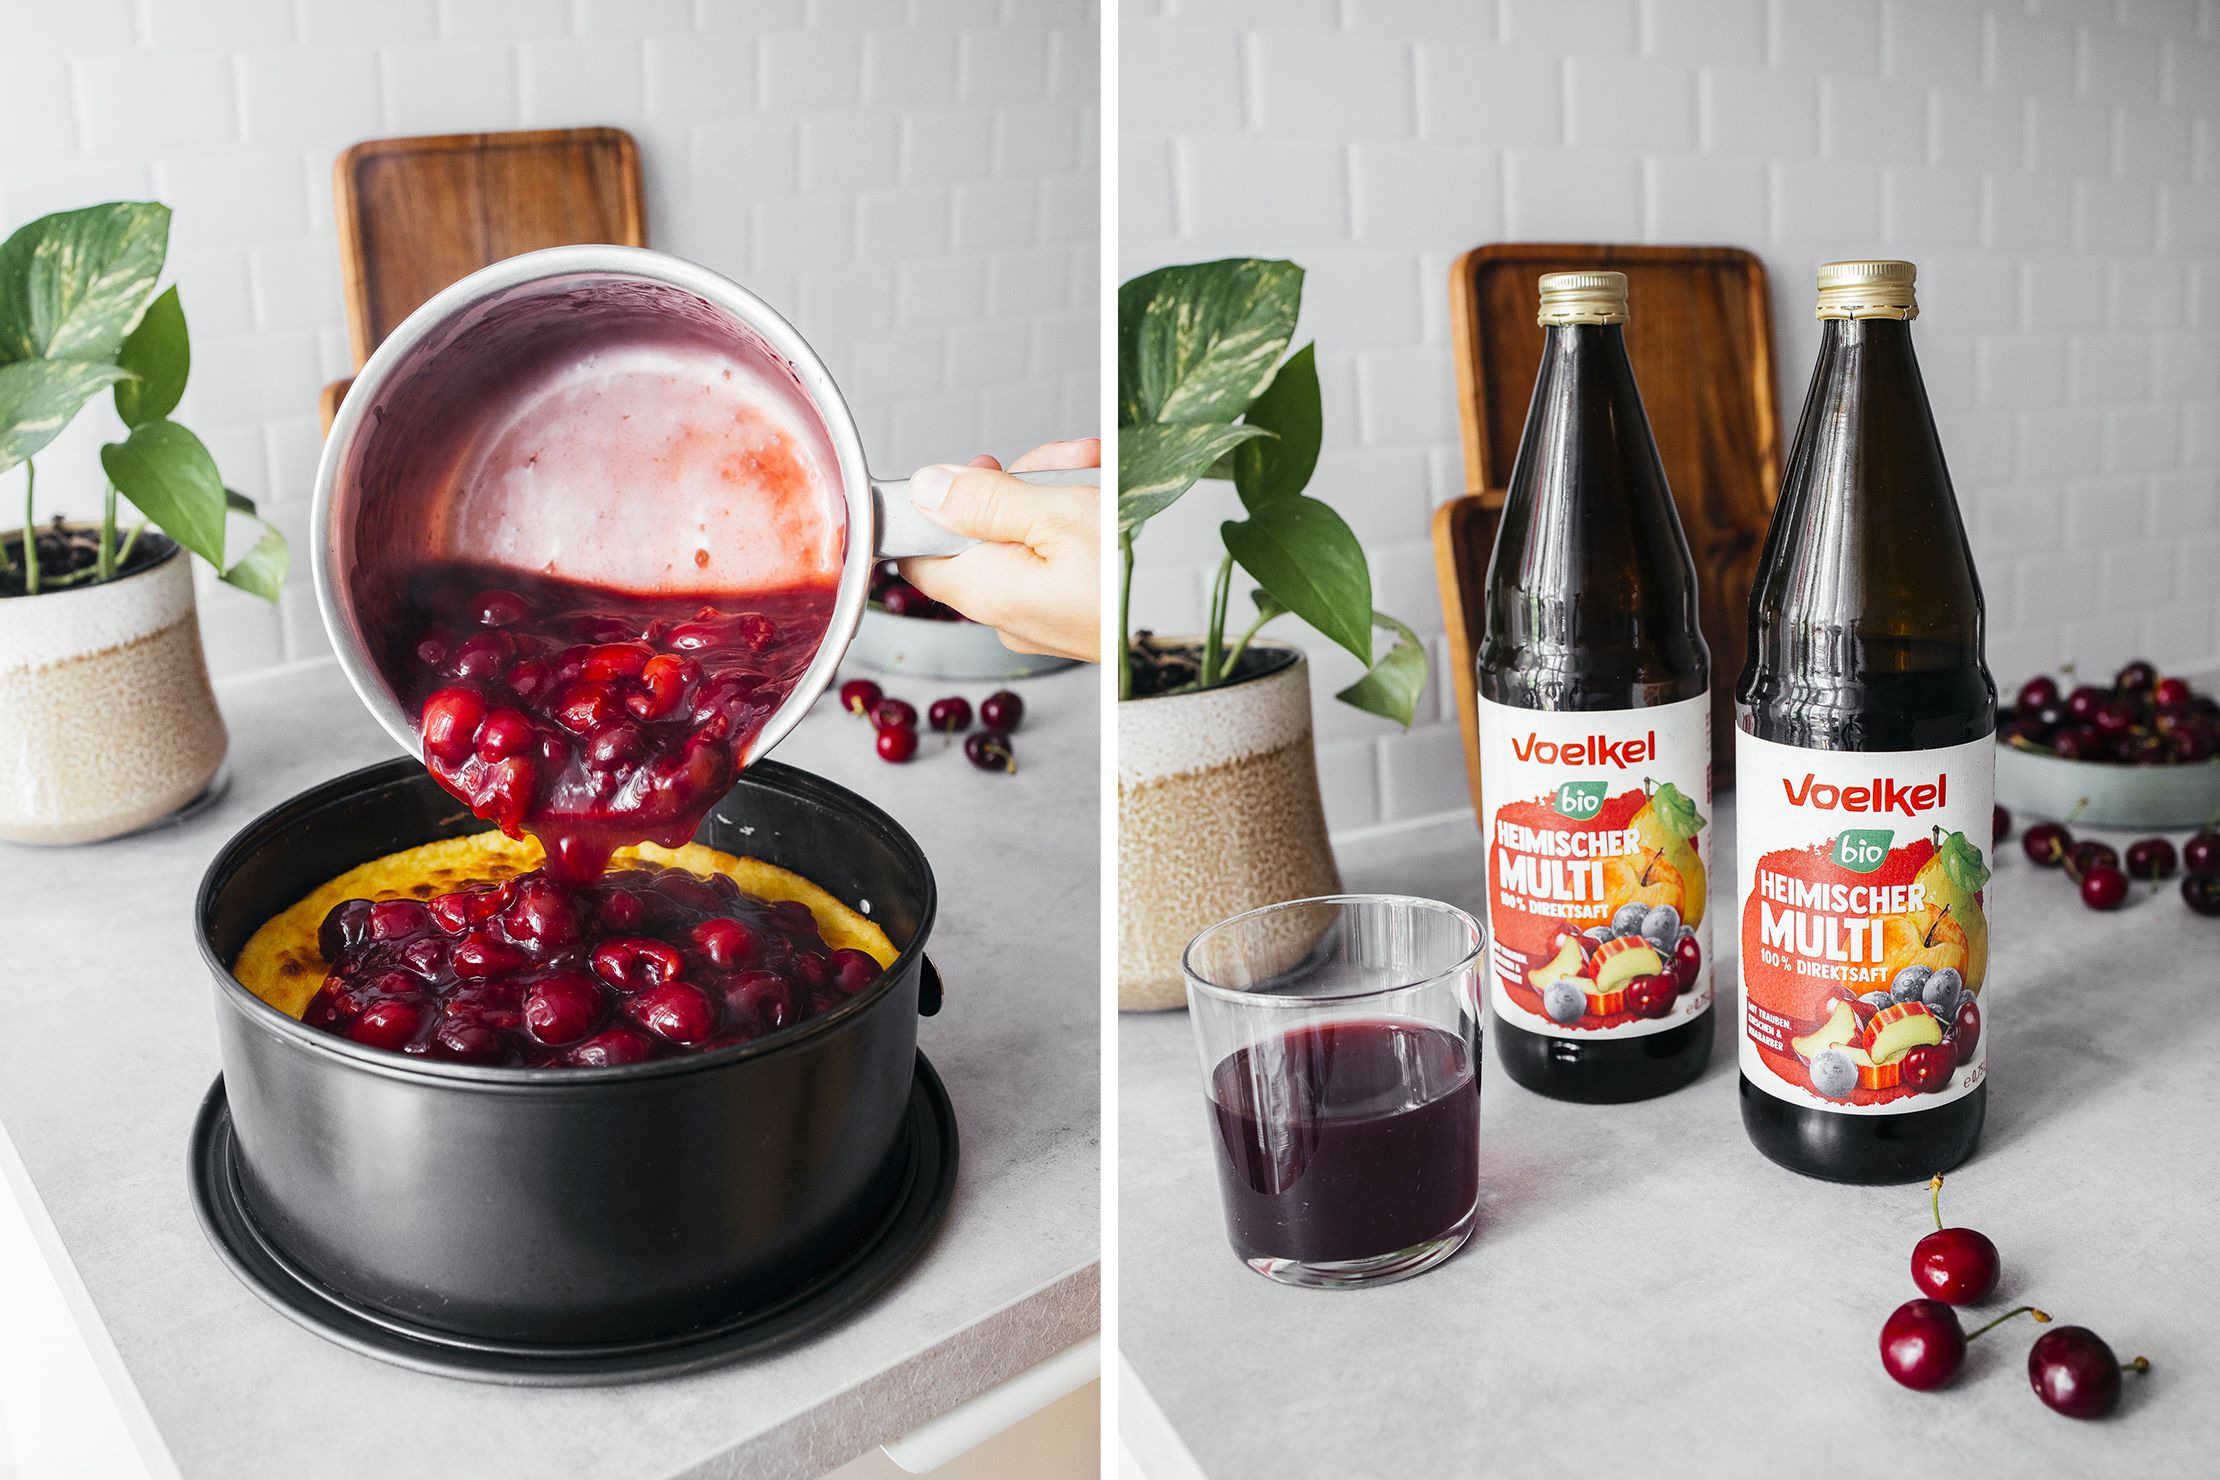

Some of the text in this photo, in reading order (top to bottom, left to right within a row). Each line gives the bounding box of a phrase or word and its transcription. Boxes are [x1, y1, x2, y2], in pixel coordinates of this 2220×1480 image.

[1512, 730, 1655, 769] Voelkel
[1562, 786, 1599, 813] bio
[1782, 773, 1946, 817] Voelkel
[1497, 819, 1640, 858] HEIMISCHER
[1841, 834, 1882, 865] bio
[1499, 848, 1605, 902] MULTI
[1761, 868, 1926, 914] HEIMISCHER
[1529, 899, 1609, 919] DIREKTSAFT
[1761, 900, 1884, 962] MULTI
[1797, 959, 1888, 982] DIREKTSAFT
